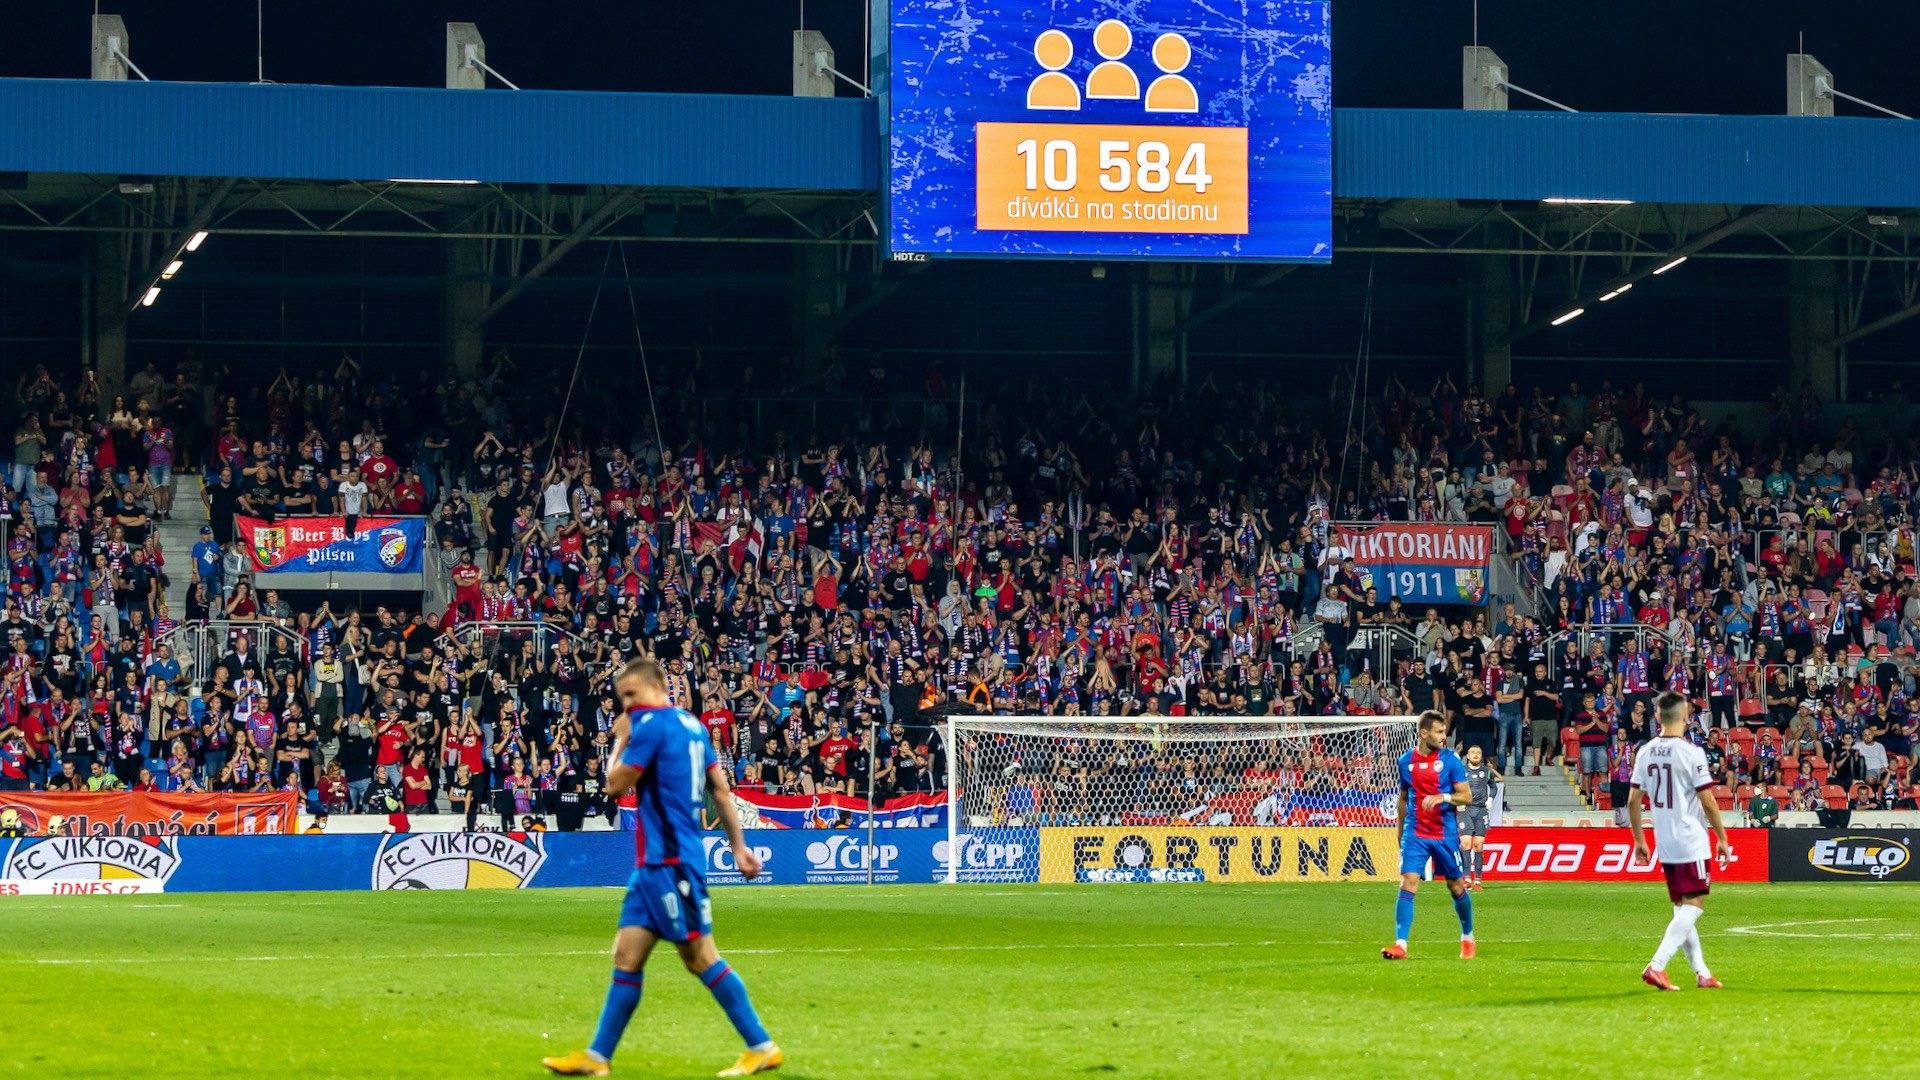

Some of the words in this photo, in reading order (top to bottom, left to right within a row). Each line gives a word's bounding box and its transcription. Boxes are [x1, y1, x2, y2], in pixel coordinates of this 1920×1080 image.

[1016, 139, 1078, 191] 10
[1098, 140, 1212, 193] 584
[1007, 196, 1079, 220] díváků
[1087, 201, 1114, 220] na
[1121, 198, 1218, 222] stadionu
[893, 252, 926, 262] HDT.cz
[290, 527, 326, 543] Beer
[1342, 528, 1484, 560] VIKTORIÁNI
[306, 548, 355, 566] Pilsen
[1386, 571, 1443, 597] 1911
[1647, 763, 1674, 810] 21
[14, 850, 46, 879] FC
[52, 834, 162, 879] VIKTORIA
[383, 846, 416, 876] FC
[420, 832, 528, 873] VIKTORIA
[842, 837, 899, 869] ČPP
[966, 836, 1023, 868] ČPP
[1073, 834, 1378, 876] FORTUNA
[1869, 865, 1890, 879] ep
[52, 882, 141, 895] iDNES.cz
